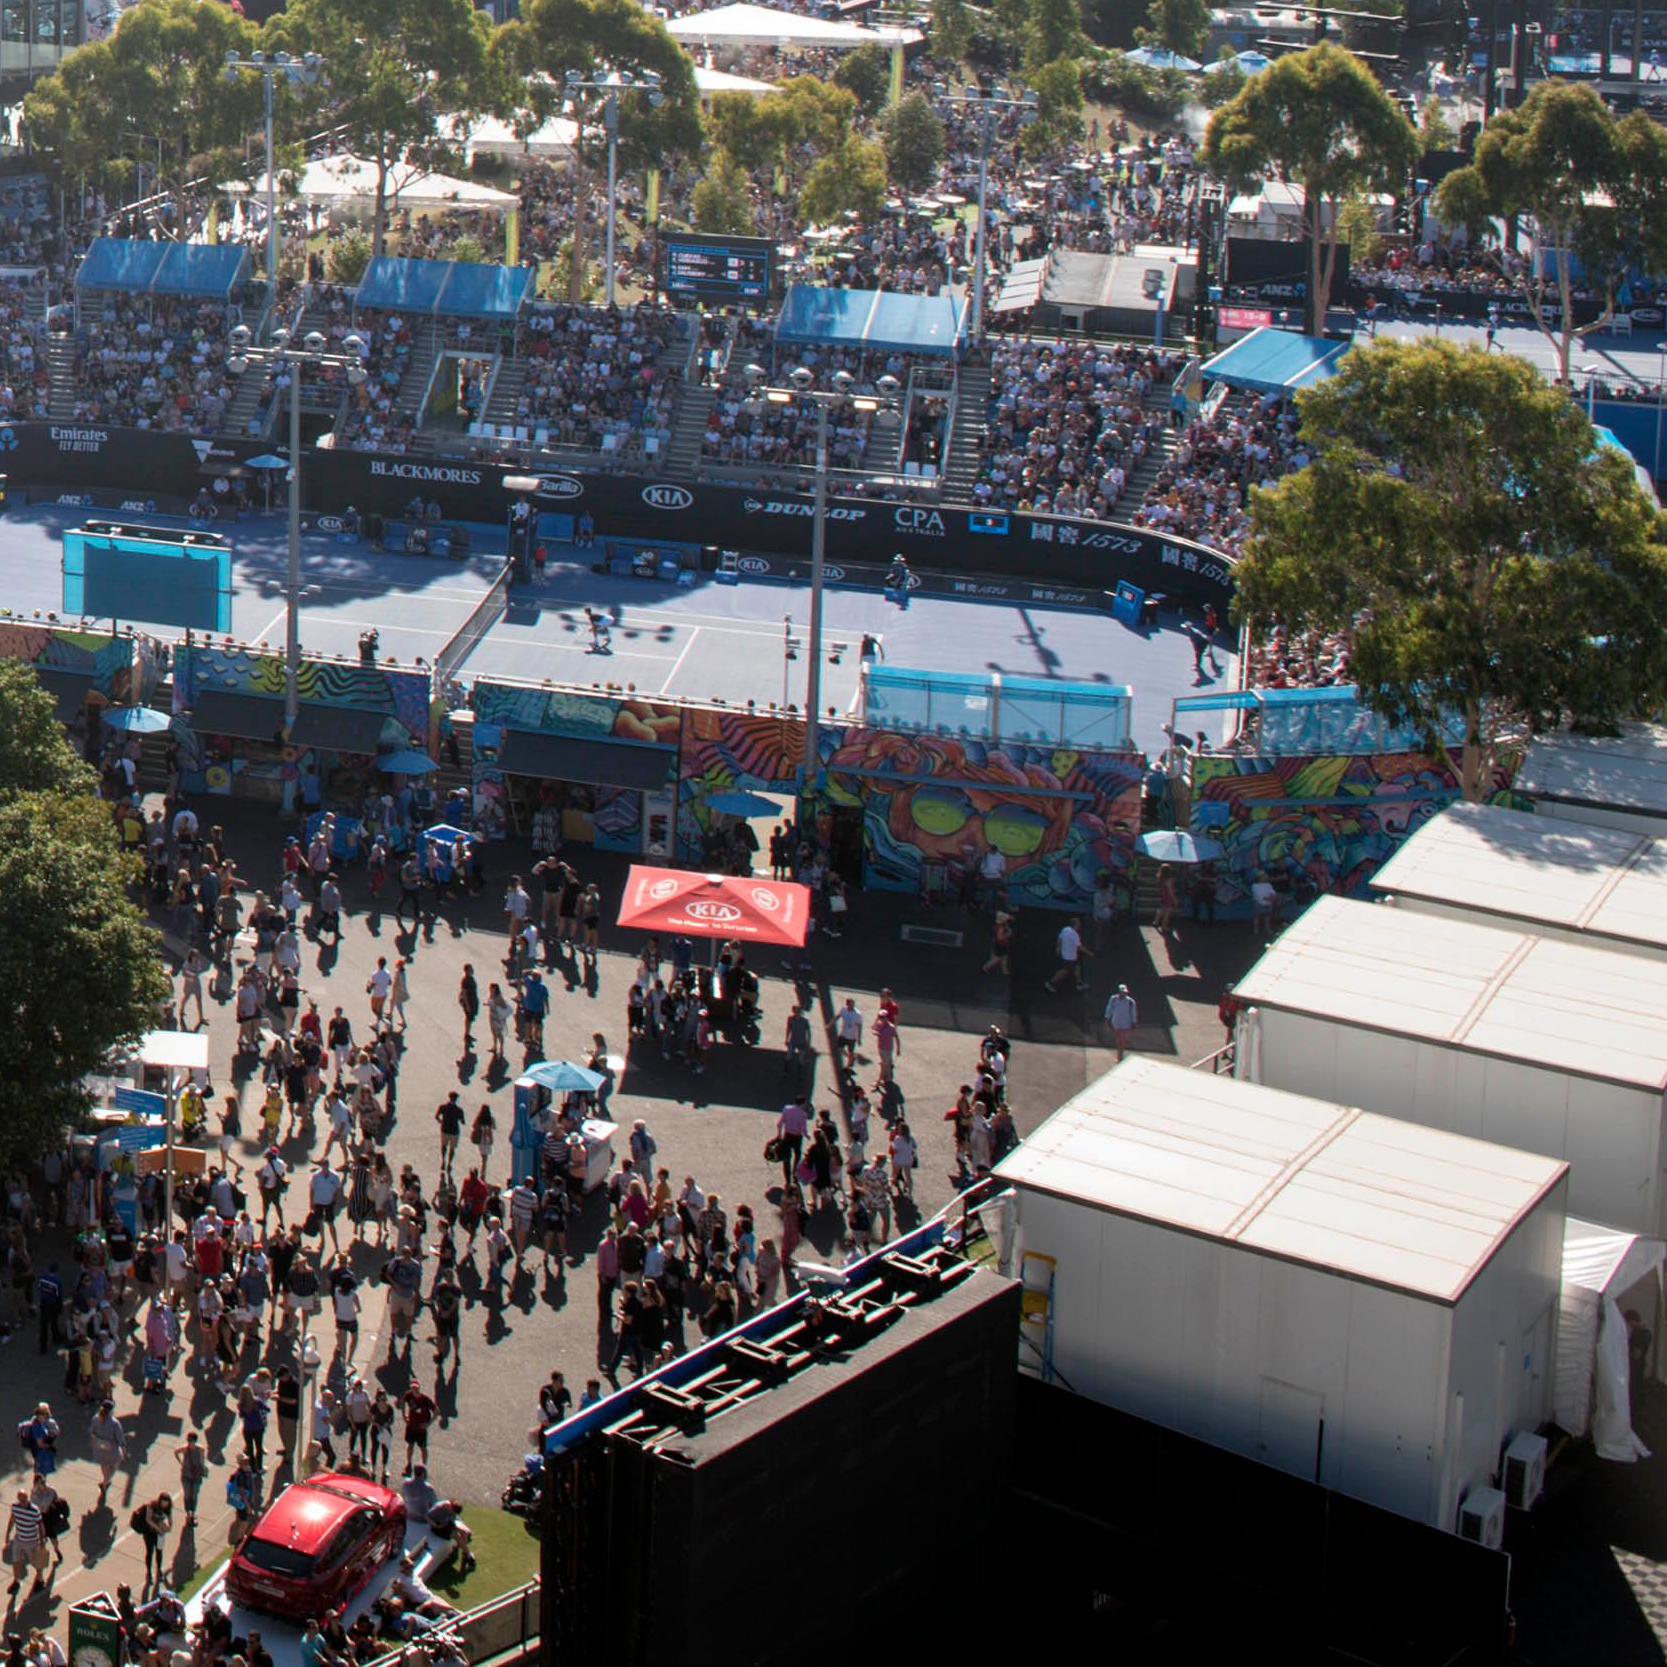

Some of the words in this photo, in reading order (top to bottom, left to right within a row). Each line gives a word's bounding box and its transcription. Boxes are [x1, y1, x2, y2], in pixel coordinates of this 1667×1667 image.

[1260, 284, 1292, 296] ANZ
[50, 426, 108, 442] Emirates
[58, 440, 73, 452] FLY
[74, 441, 100, 453] BETTER
[370, 461, 481, 485] BLACKMORES
[57, 494, 81, 506] ANZ
[650, 488, 685, 506] KIA
[120, 501, 144, 512] ANZ
[322, 518, 342, 529] KIA
[894, 507, 946, 530] CPA
[895, 526, 946, 537] AUSTRALIA
[742, 560, 765, 571] KIA
[694, 903, 734, 919] KIA
[76, 1628, 110, 1642] ROLEX
